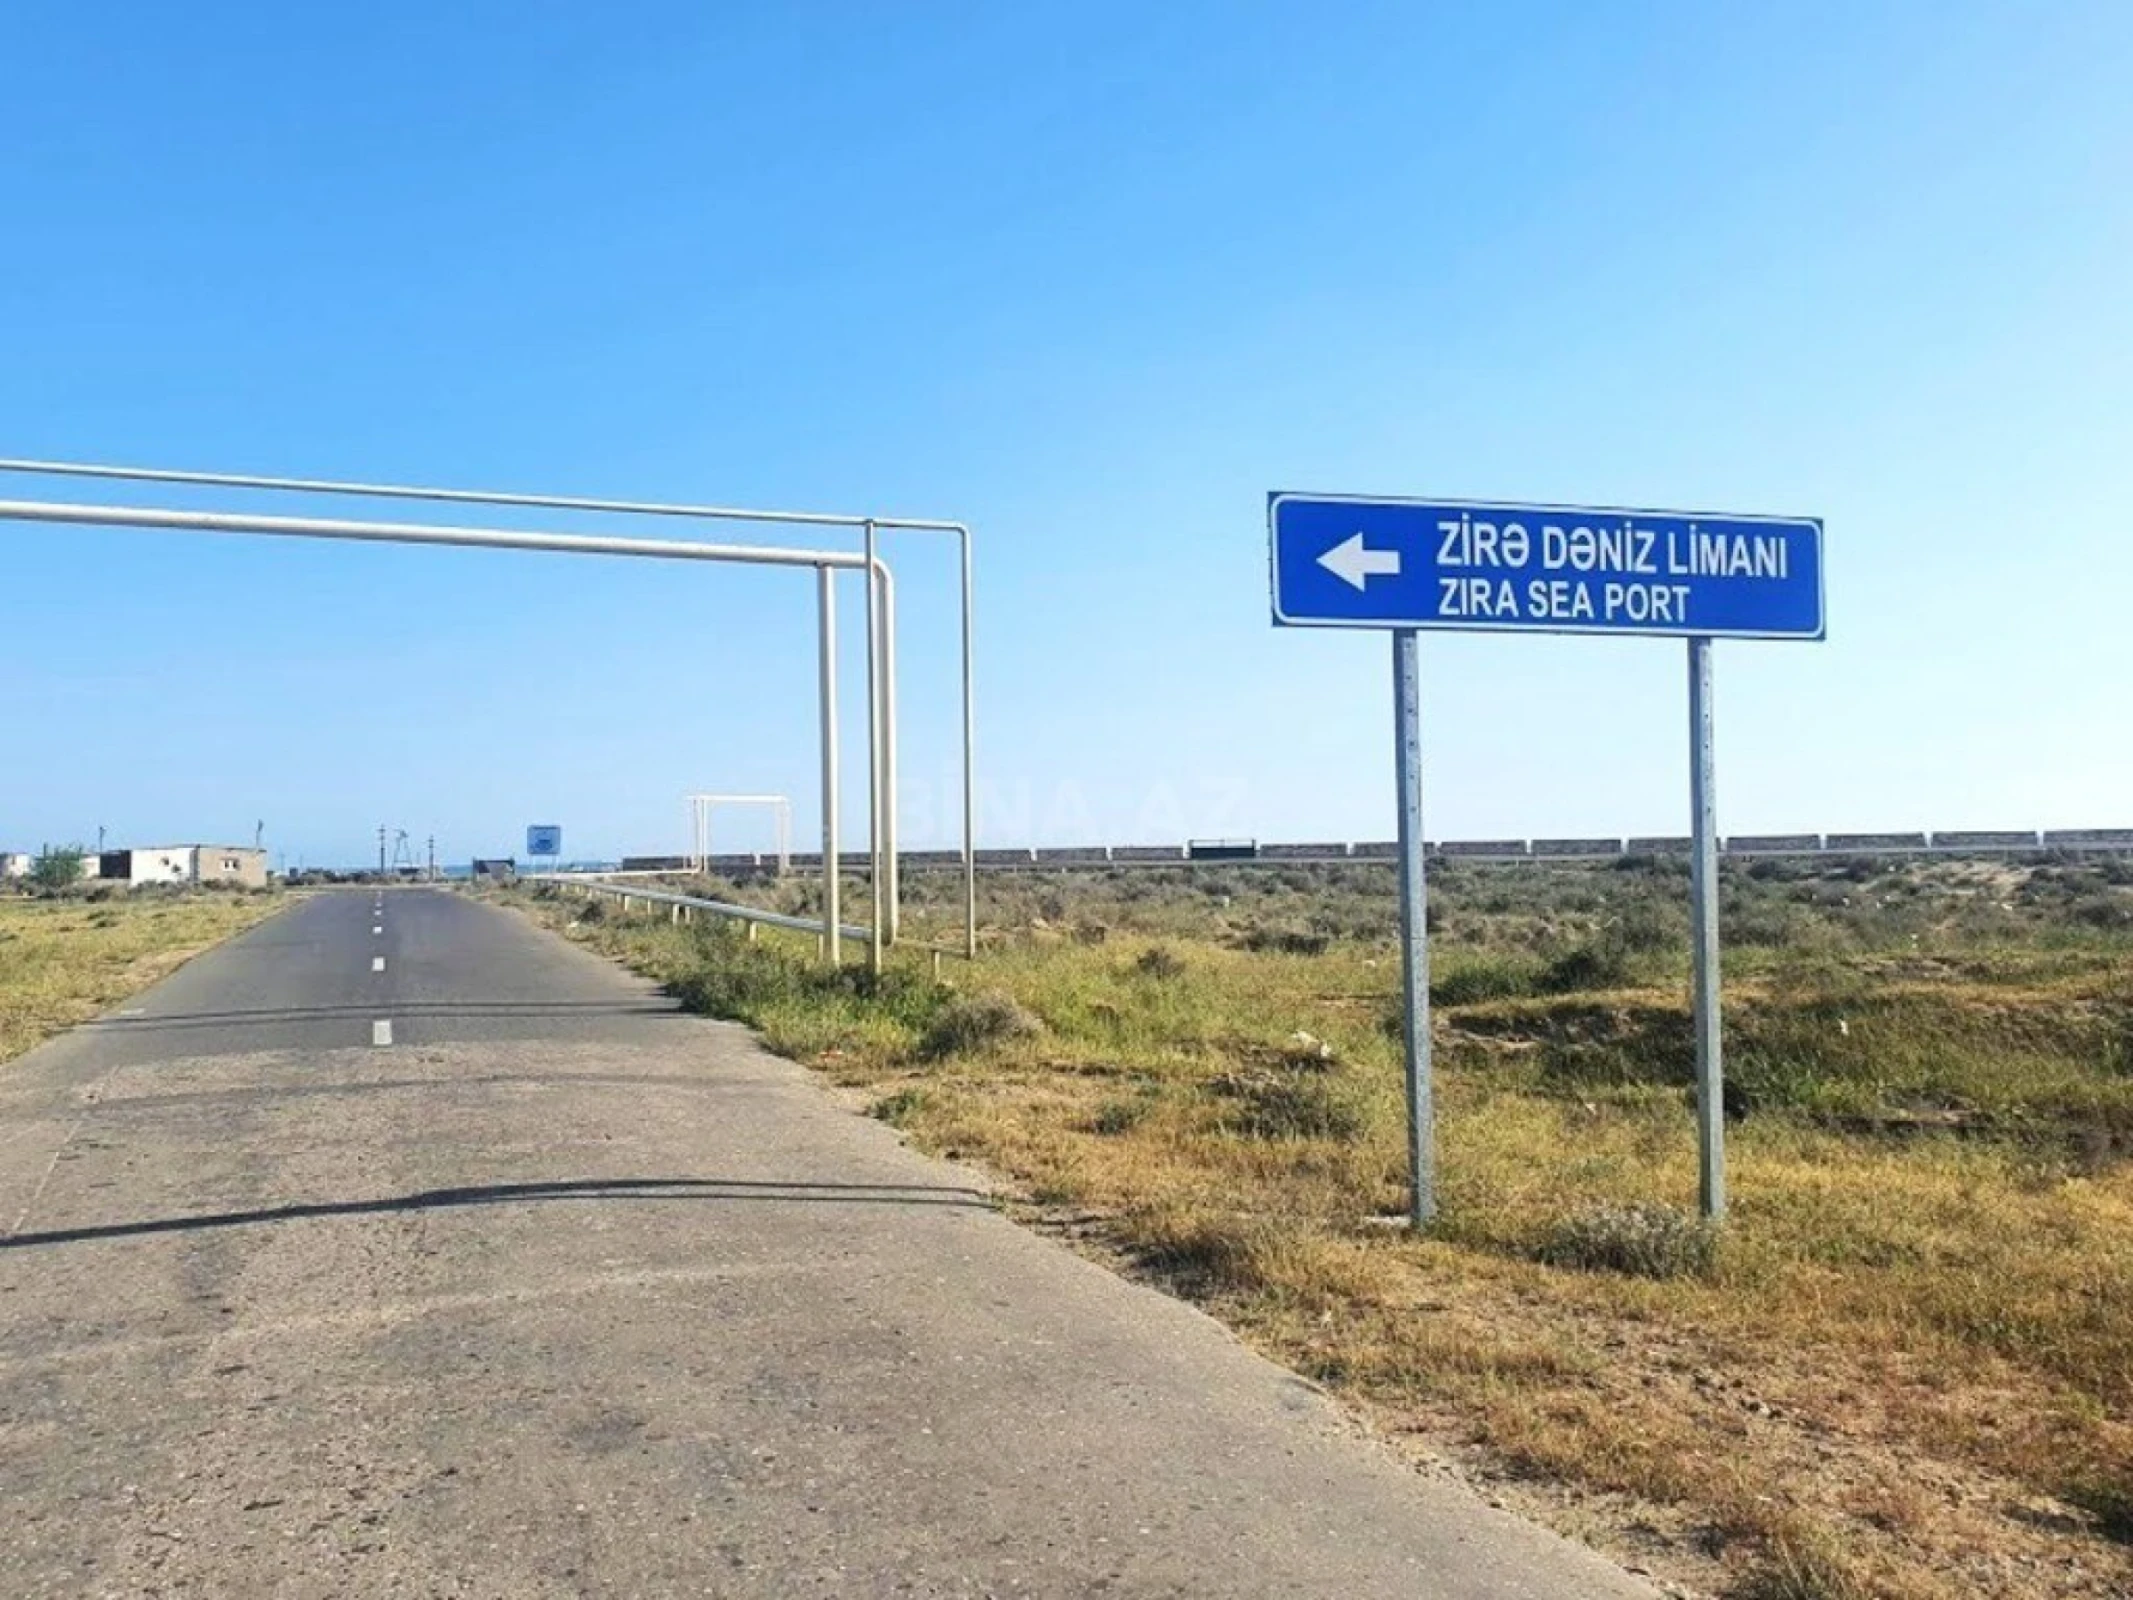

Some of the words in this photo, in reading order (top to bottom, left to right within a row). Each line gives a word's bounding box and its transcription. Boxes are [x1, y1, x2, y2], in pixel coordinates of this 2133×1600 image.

[1437, 513, 1531, 567] ZİRƏ
[1542, 521, 1657, 573] DƏNİZ
[1667, 524, 1787, 578] LİMANI
[1438, 578, 1520, 616] ZIRA
[1528, 580, 1595, 619] SEA
[1605, 583, 1690, 621] PORT
